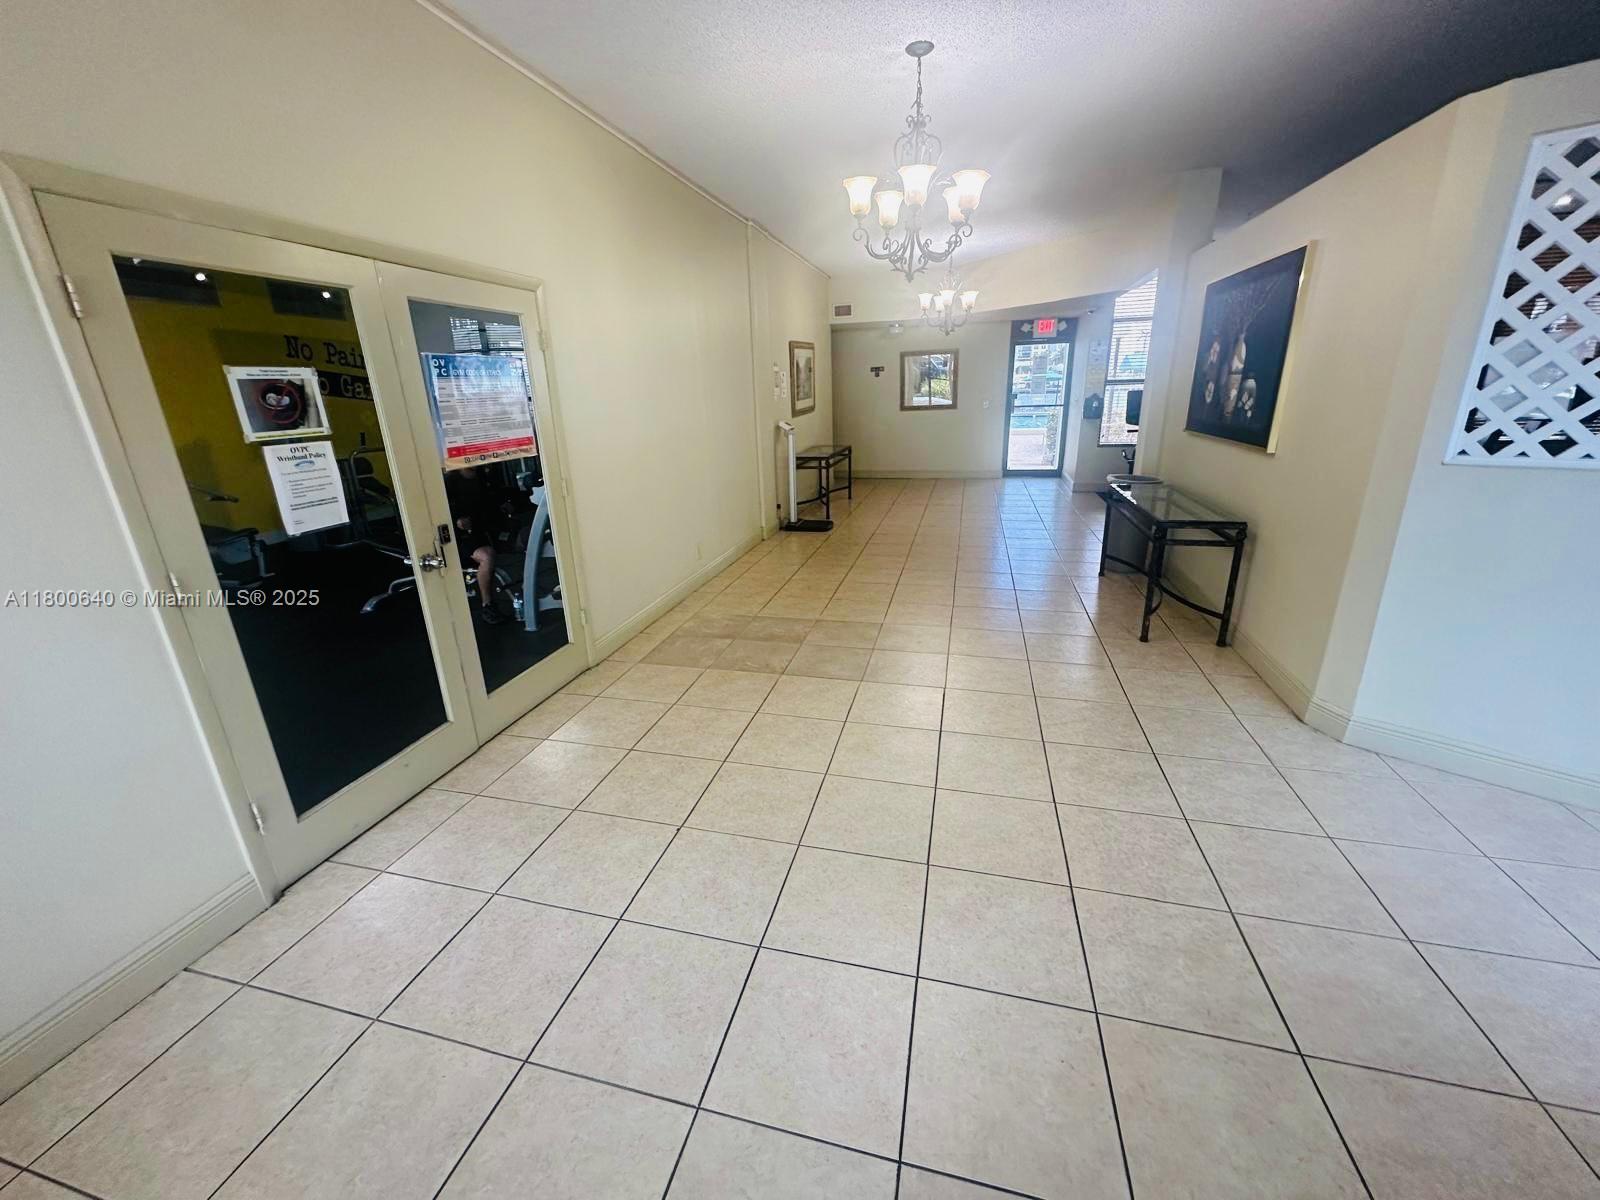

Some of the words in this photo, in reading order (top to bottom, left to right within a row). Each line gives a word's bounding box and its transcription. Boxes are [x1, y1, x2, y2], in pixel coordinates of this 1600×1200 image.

[284, 335, 313, 361] No
[290, 446, 311, 454] OVPC
[277, 454, 307, 462] Wristband
